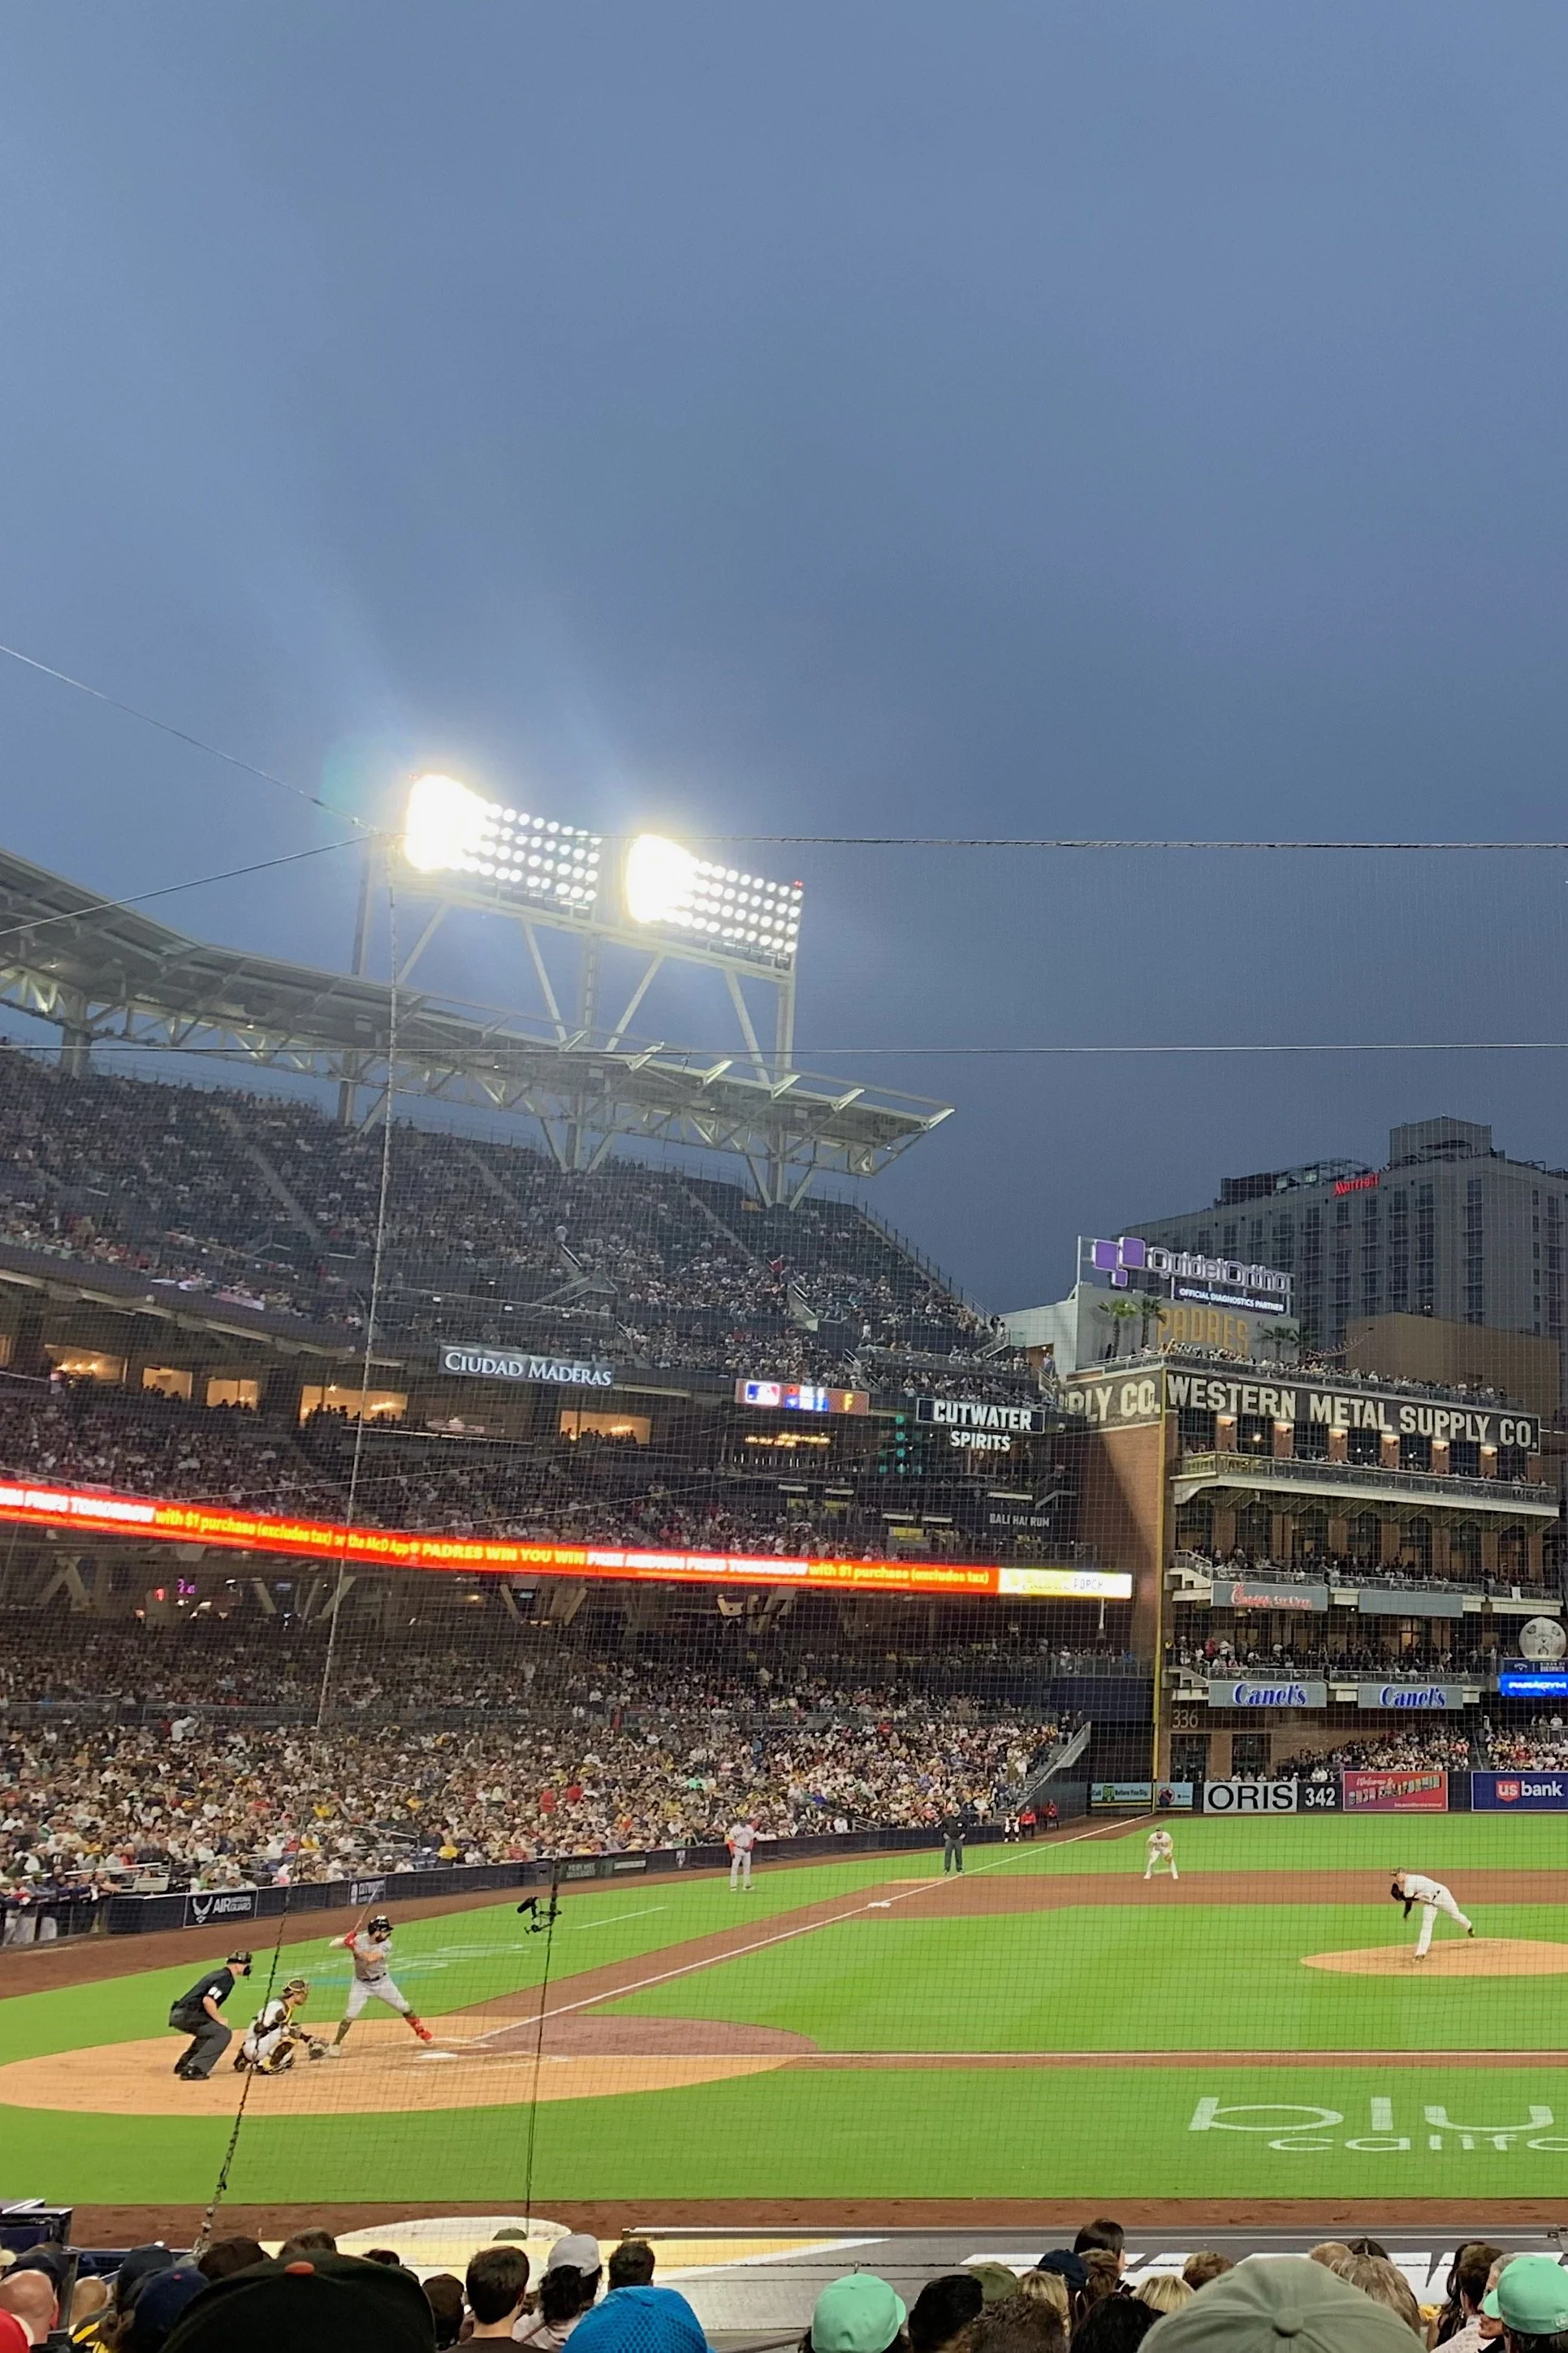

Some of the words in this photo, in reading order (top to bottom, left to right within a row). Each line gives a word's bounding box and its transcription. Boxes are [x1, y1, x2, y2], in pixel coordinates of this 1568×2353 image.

[1333, 1172, 1380, 1197] Marriott
[1147, 1246, 1289, 1293] QuidelOrtho
[1178, 1286, 1209, 1300] OFFICIAL
[1210, 1292, 1254, 1307] DIAGNOSTICS
[1255, 1299, 1284, 1311] PARTNER
[1155, 1307, 1251, 1358] PADRES
[444, 1352, 524, 1377] CIUDAD
[528, 1361, 611, 1386] MADERAS
[1120, 1379, 1161, 1418] CO.
[933, 1401, 1032, 1431] CUTWATER
[1166, 1374, 1296, 1421] WESTERN
[1309, 1392, 1393, 1431] METAL
[1399, 1405, 1491, 1443] SUPPLY
[1500, 1418, 1538, 1449] CO.
[950, 1430, 1011, 1452] SPIRITS
[989, 1513, 1010, 1525] BALI
[1013, 1514, 1028, 1526] HAI
[1030, 1516, 1050, 1527] RUM
[155, 1508, 184, 1525] with
[185, 1511, 201, 1528] $1
[201, 1515, 256, 1536] purchase
[257, 1521, 309, 1542] (excludes
[311, 1528, 333, 1547] tax)
[348, 1532, 365, 1549] the
[365, 1535, 389, 1552] McD
[421, 1542, 483, 1561] PADRES
[486, 1545, 518, 1562] WIN
[519, 1548, 553, 1563] YOU
[554, 1549, 585, 1565] WIN
[809, 1562, 836, 1578] with
[838, 1564, 852, 1578] $1
[853, 1565, 910, 1582] purchase
[910, 1567, 966, 1582] (excludes
[967, 1570, 989, 1585] tax)
[1233, 1682, 1308, 1707] Canel's
[1380, 1686, 1446, 1709] Canel's
[1171, 1708, 1199, 1729] 336
[1207, 1785, 1294, 1810] ORIS
[1304, 1786, 1336, 1807] 342
[1497, 1785, 1519, 1797] us
[1520, 1781, 1564, 1797] bank
[212, 1897, 231, 1914] AIR
[231, 1902, 252, 1912] GUARD
